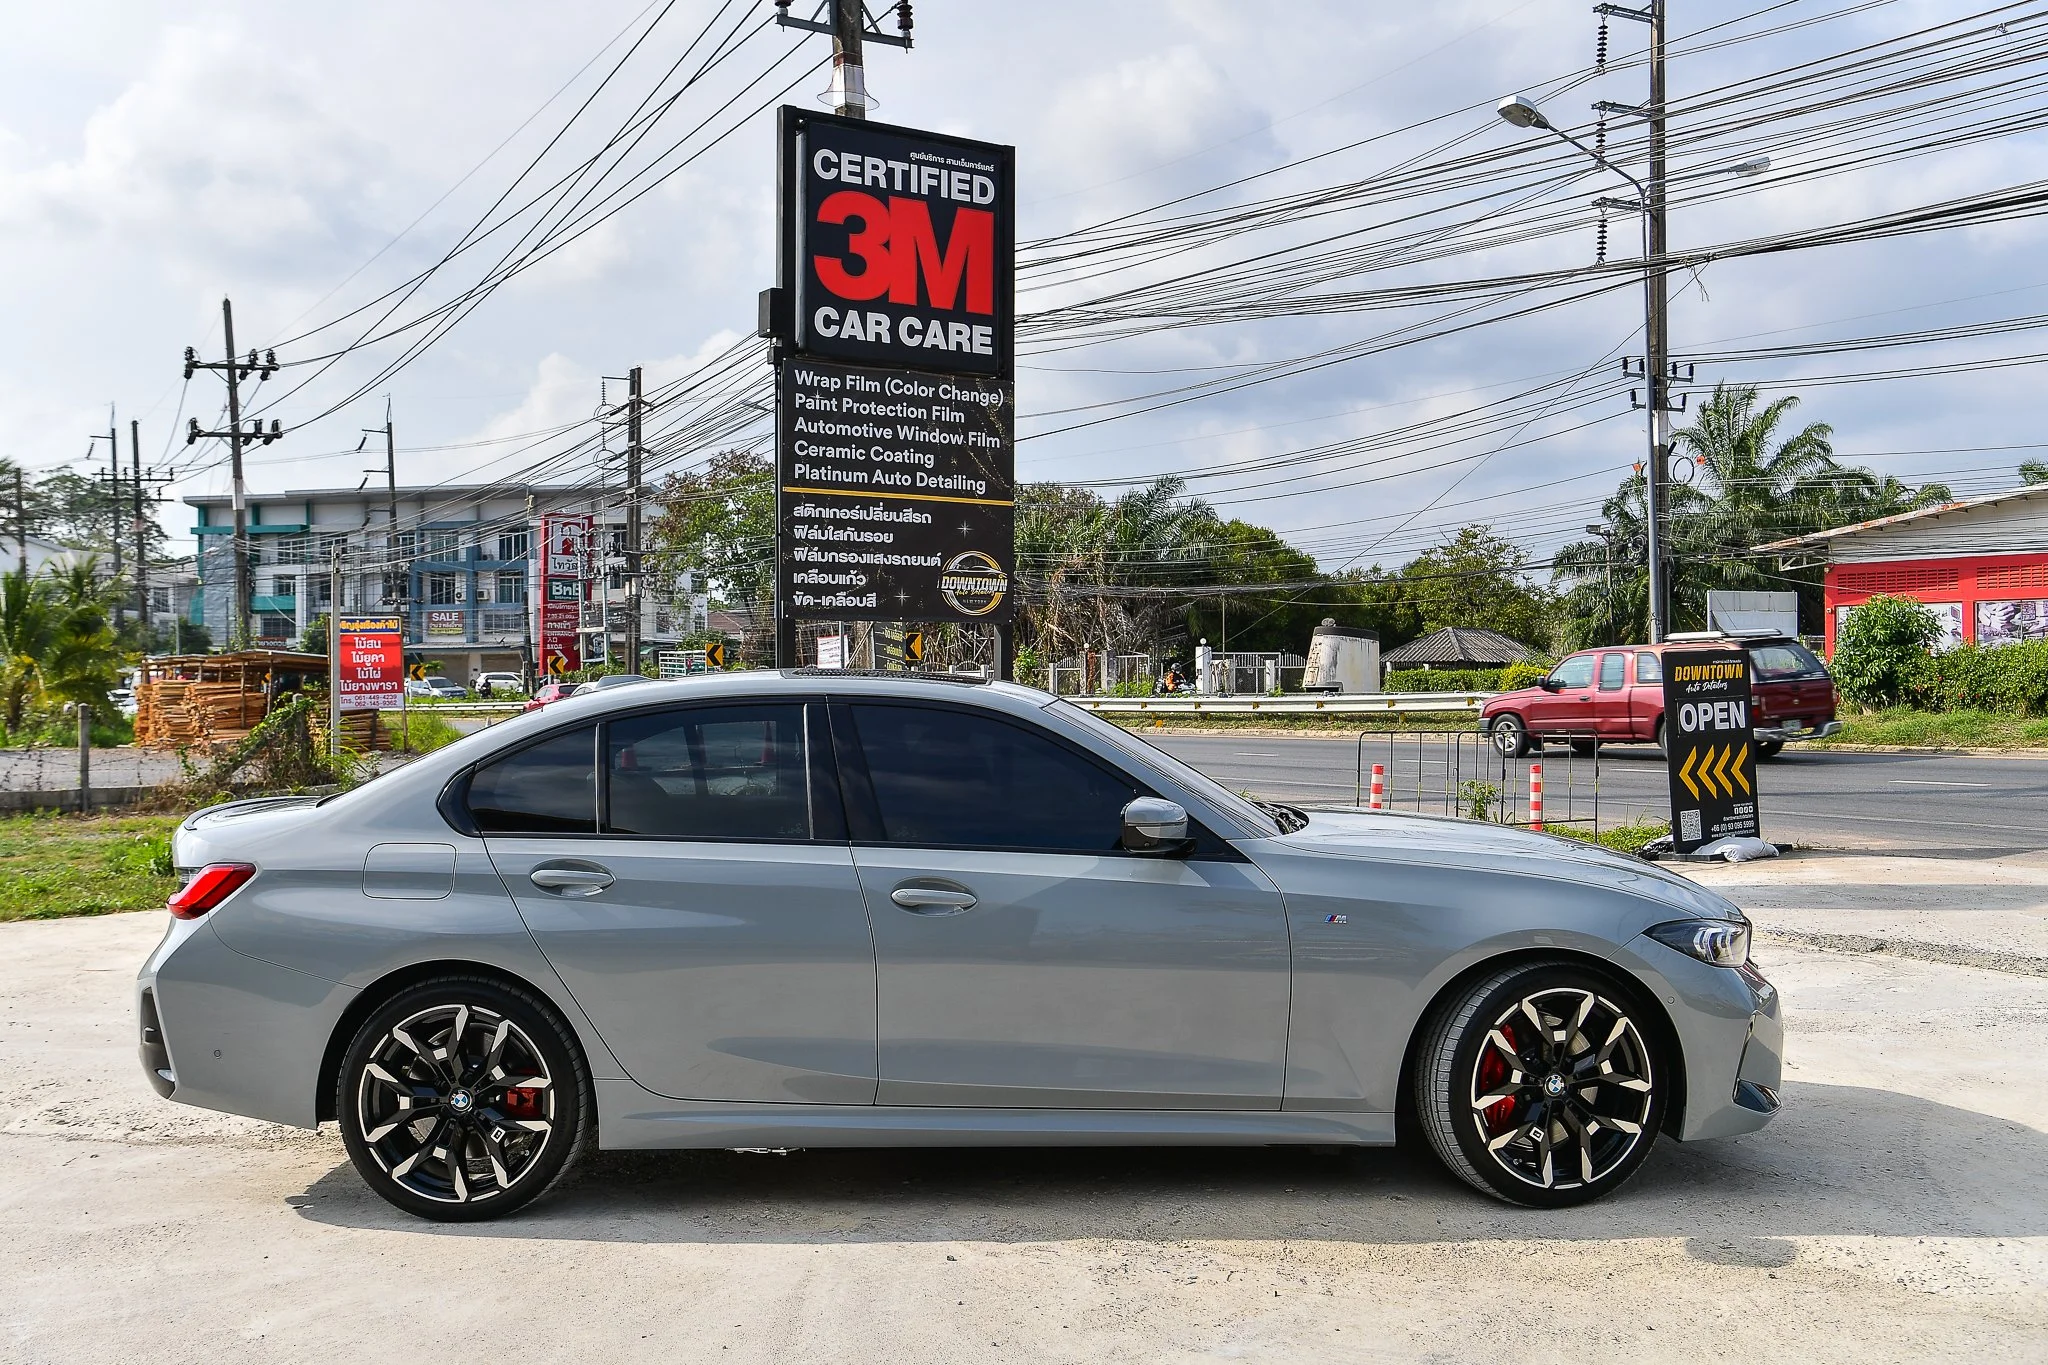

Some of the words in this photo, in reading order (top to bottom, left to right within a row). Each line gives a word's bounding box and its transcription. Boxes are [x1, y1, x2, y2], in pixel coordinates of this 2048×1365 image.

[813, 148, 995, 205] CERTIFIED
[813, 190, 994, 316] 3M
[814, 306, 891, 344] CAR
[899, 316, 993, 355] CARE
[794, 369, 841, 391] Wrap
[845, 374, 881, 393] Film
[884, 377, 935, 397] (Color
[938, 384, 1004, 407] Change)
[794, 392, 838, 412] Paint
[842, 397, 928, 420] Protection
[931, 405, 965, 423] Film
[794, 416, 893, 439] Automotive
[896, 424, 963, 445] Window
[968, 431, 1000, 448] Film
[794, 440, 866, 460] Ceramic
[870, 446, 935, 468] Coating
[794, 463, 868, 484] Platinum
[872, 469, 912, 486] Auto
[916, 471, 986, 495] Detailing
[793, 502, 932, 524] สติกเกอร์เปลี่ยนสีรถ
[793, 525, 894, 543] ฟิล์มใสกันรอย
[793, 547, 942, 567] ฟิล์มกรองแสงรถยนต์
[793, 568, 867, 586] เคลือบแก้ว
[941, 576, 1008, 592] DOWNTOWN
[792, 590, 877, 608] ขัด-เคลือบสี
[432, 612, 459, 622] SALE
[354, 637, 382, 649] ไม้สน
[351, 651, 385, 667] ไม้ยูคา
[356, 667, 381, 679] ไม้ไผ่
[1675, 664, 1743, 681] DOWNTOWN
[340, 680, 398, 692] ไม้ยางพารา
[1685, 682, 1701, 693] Auto
[1679, 700, 1746, 733] OPEN
